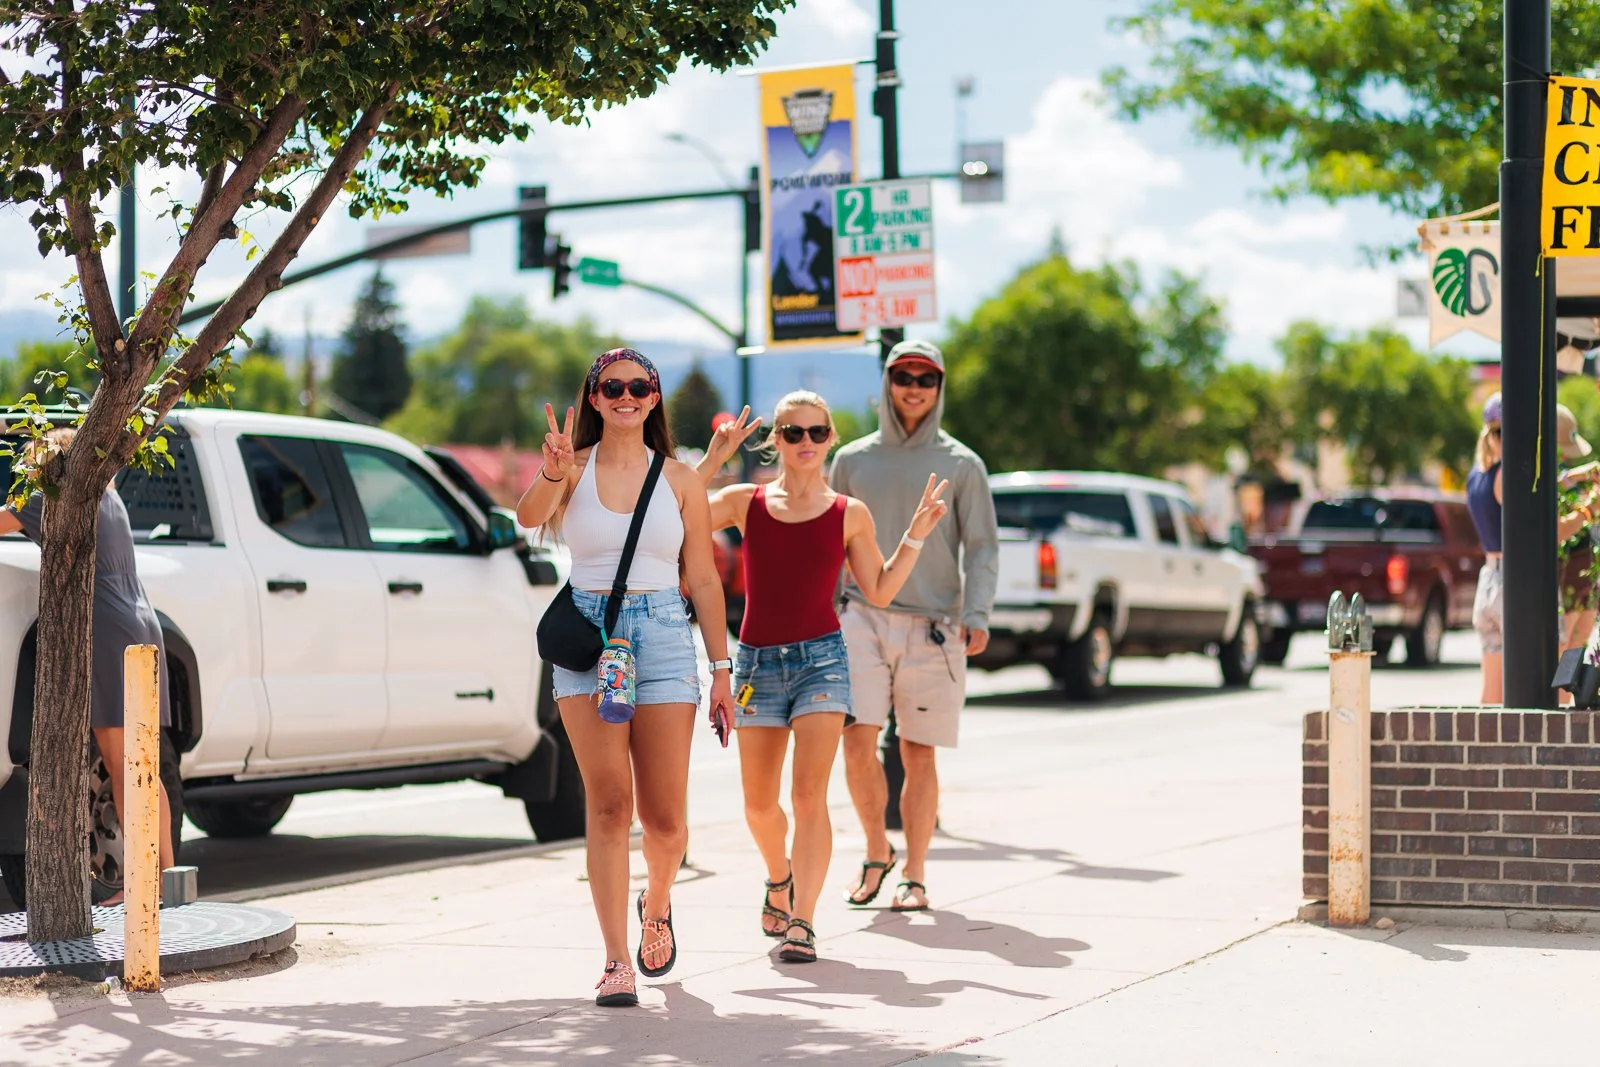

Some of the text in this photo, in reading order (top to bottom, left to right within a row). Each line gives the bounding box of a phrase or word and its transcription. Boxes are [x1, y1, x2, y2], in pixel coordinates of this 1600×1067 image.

[843, 189, 909, 234] 2 HR
[871, 207, 931, 228] PARKING
[842, 260, 932, 294] NO PARKING
